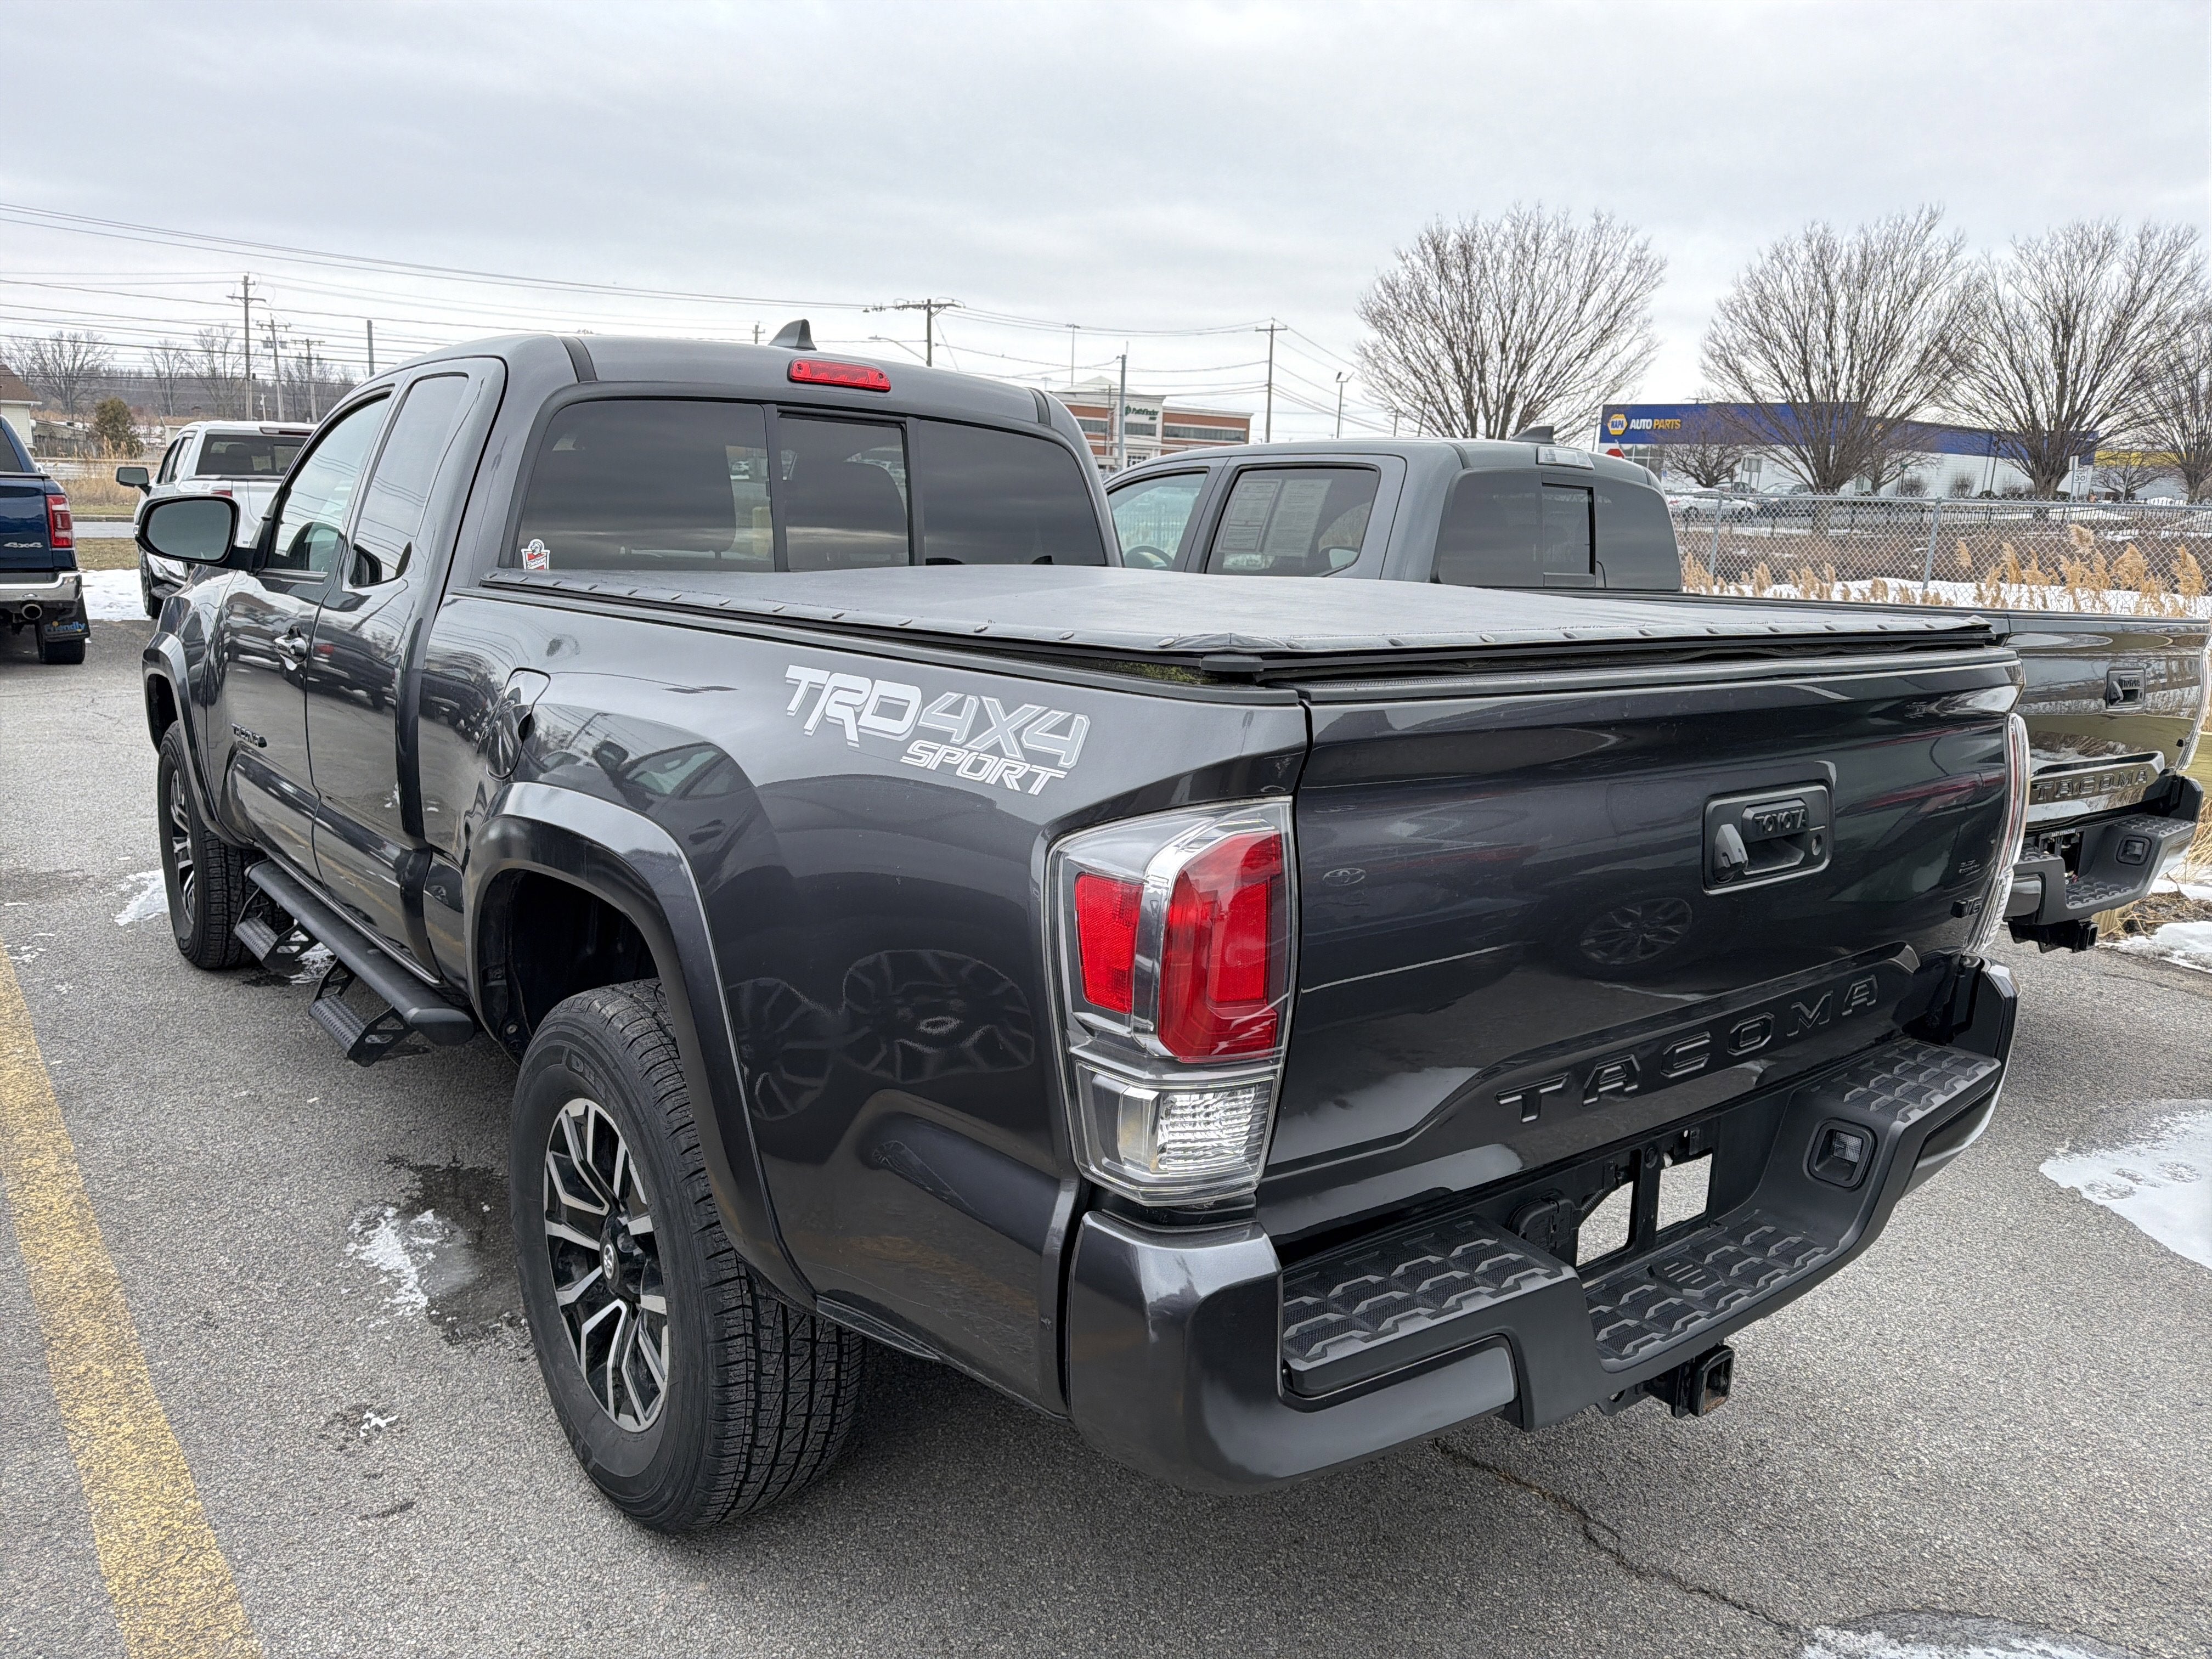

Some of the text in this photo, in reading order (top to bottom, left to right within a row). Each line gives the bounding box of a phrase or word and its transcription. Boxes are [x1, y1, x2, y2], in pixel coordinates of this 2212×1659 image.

[1611, 419, 1681, 430] NAPA AUTO PARTS
[785, 665, 922, 747] TRD
[900, 740, 1067, 795] SPORT
[2032, 768, 2147, 800] TACOMA
[1495, 974, 1879, 1123] TACOMA
